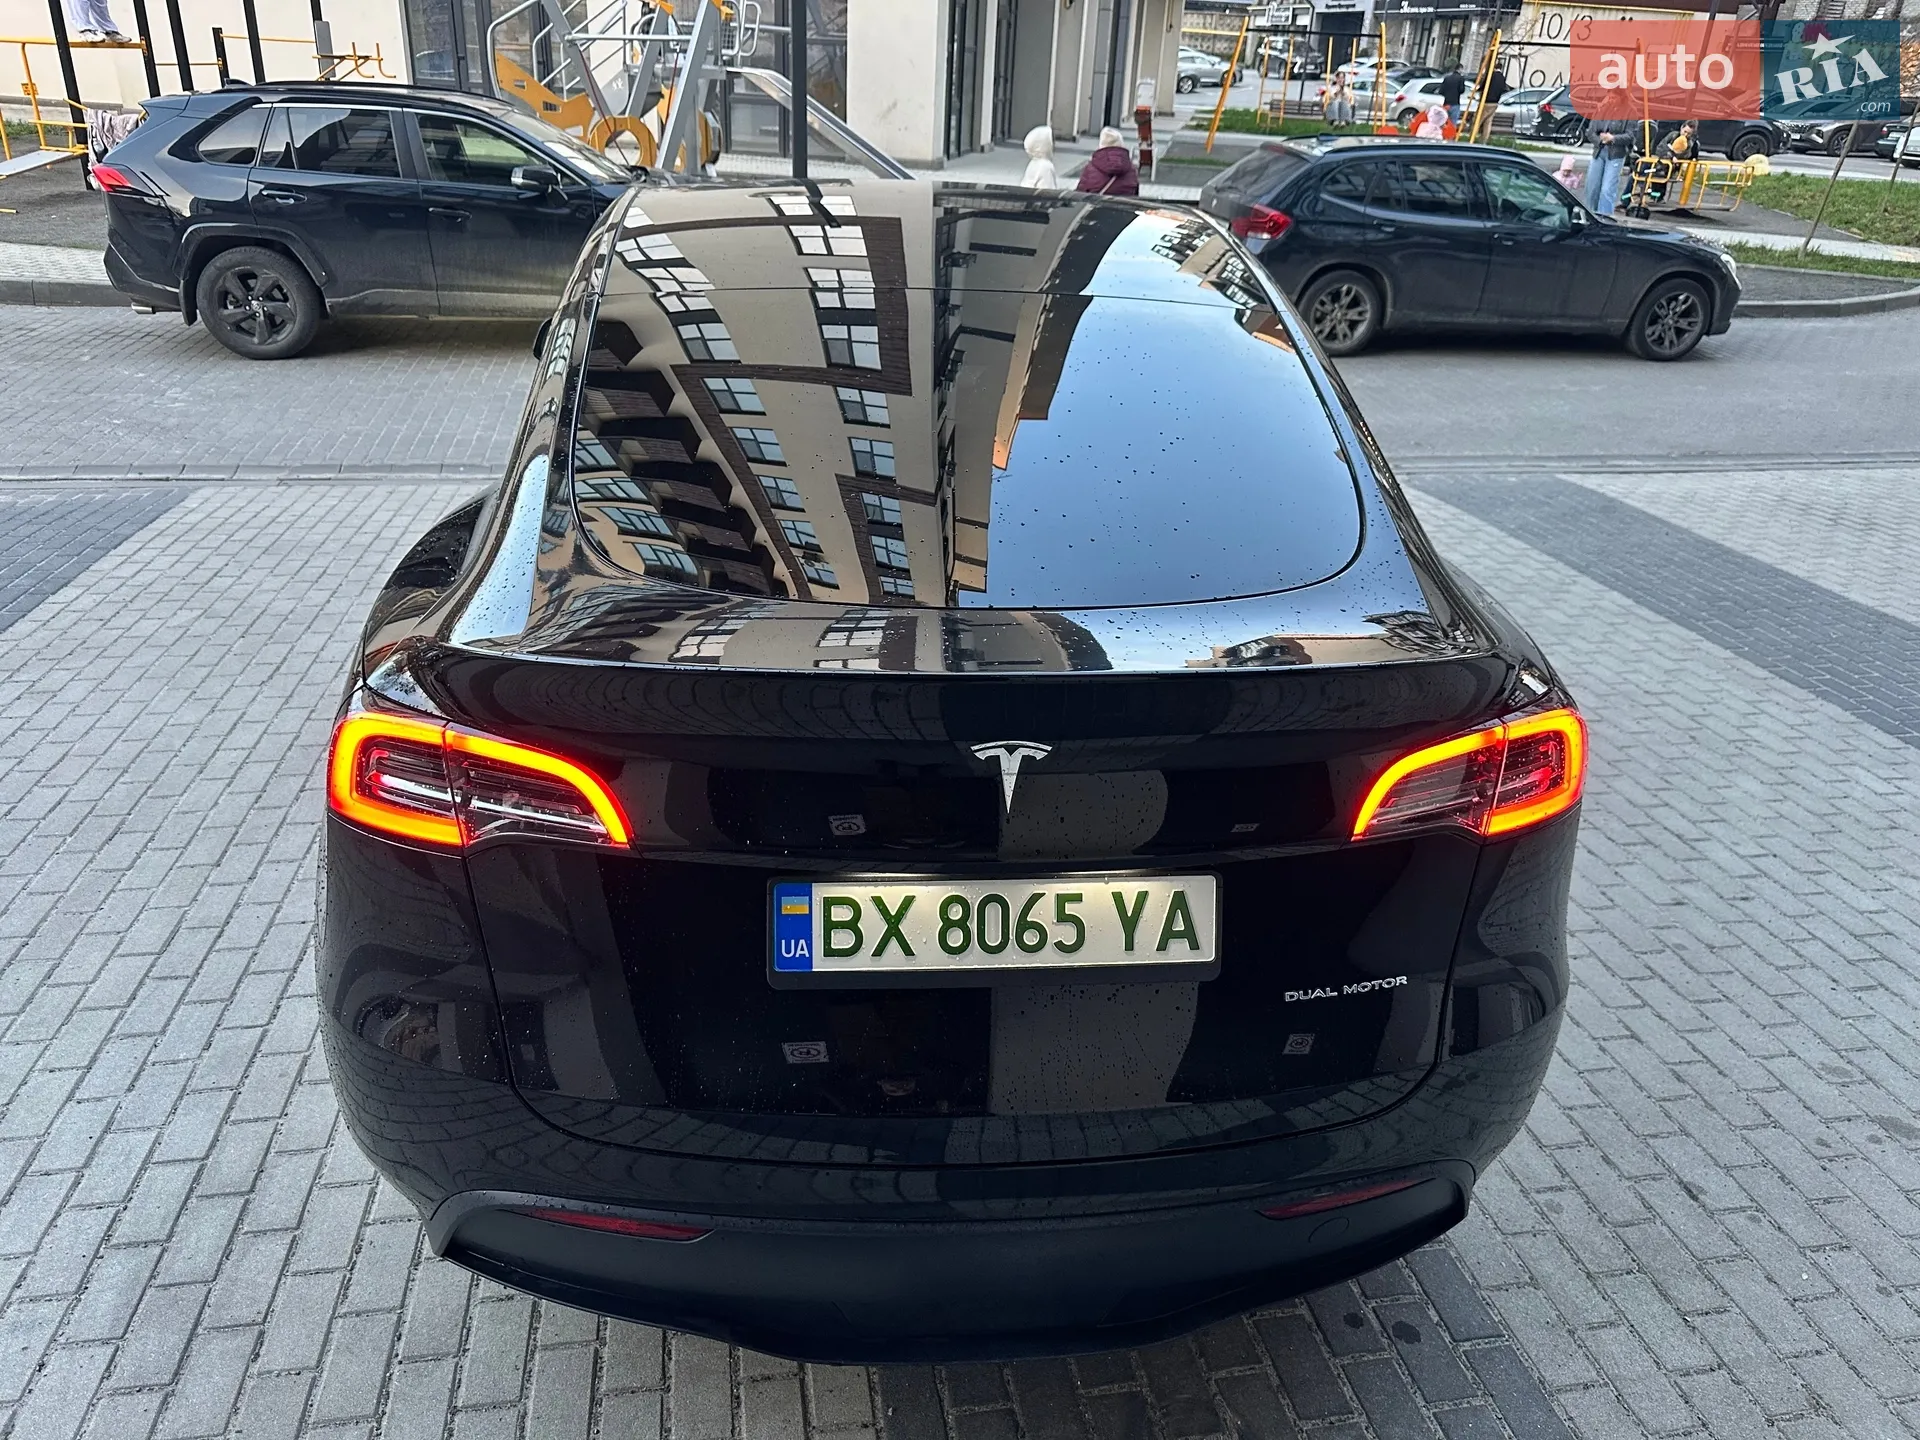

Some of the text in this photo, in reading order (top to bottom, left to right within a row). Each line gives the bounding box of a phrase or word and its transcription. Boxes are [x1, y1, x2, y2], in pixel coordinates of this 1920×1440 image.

[1539, 12, 1593, 41] 10/3
[821, 890, 1200, 958] BX 8065 YA
[781, 939, 810, 958] UA
[1285, 975, 1408, 1002] DUAL MOTOR
